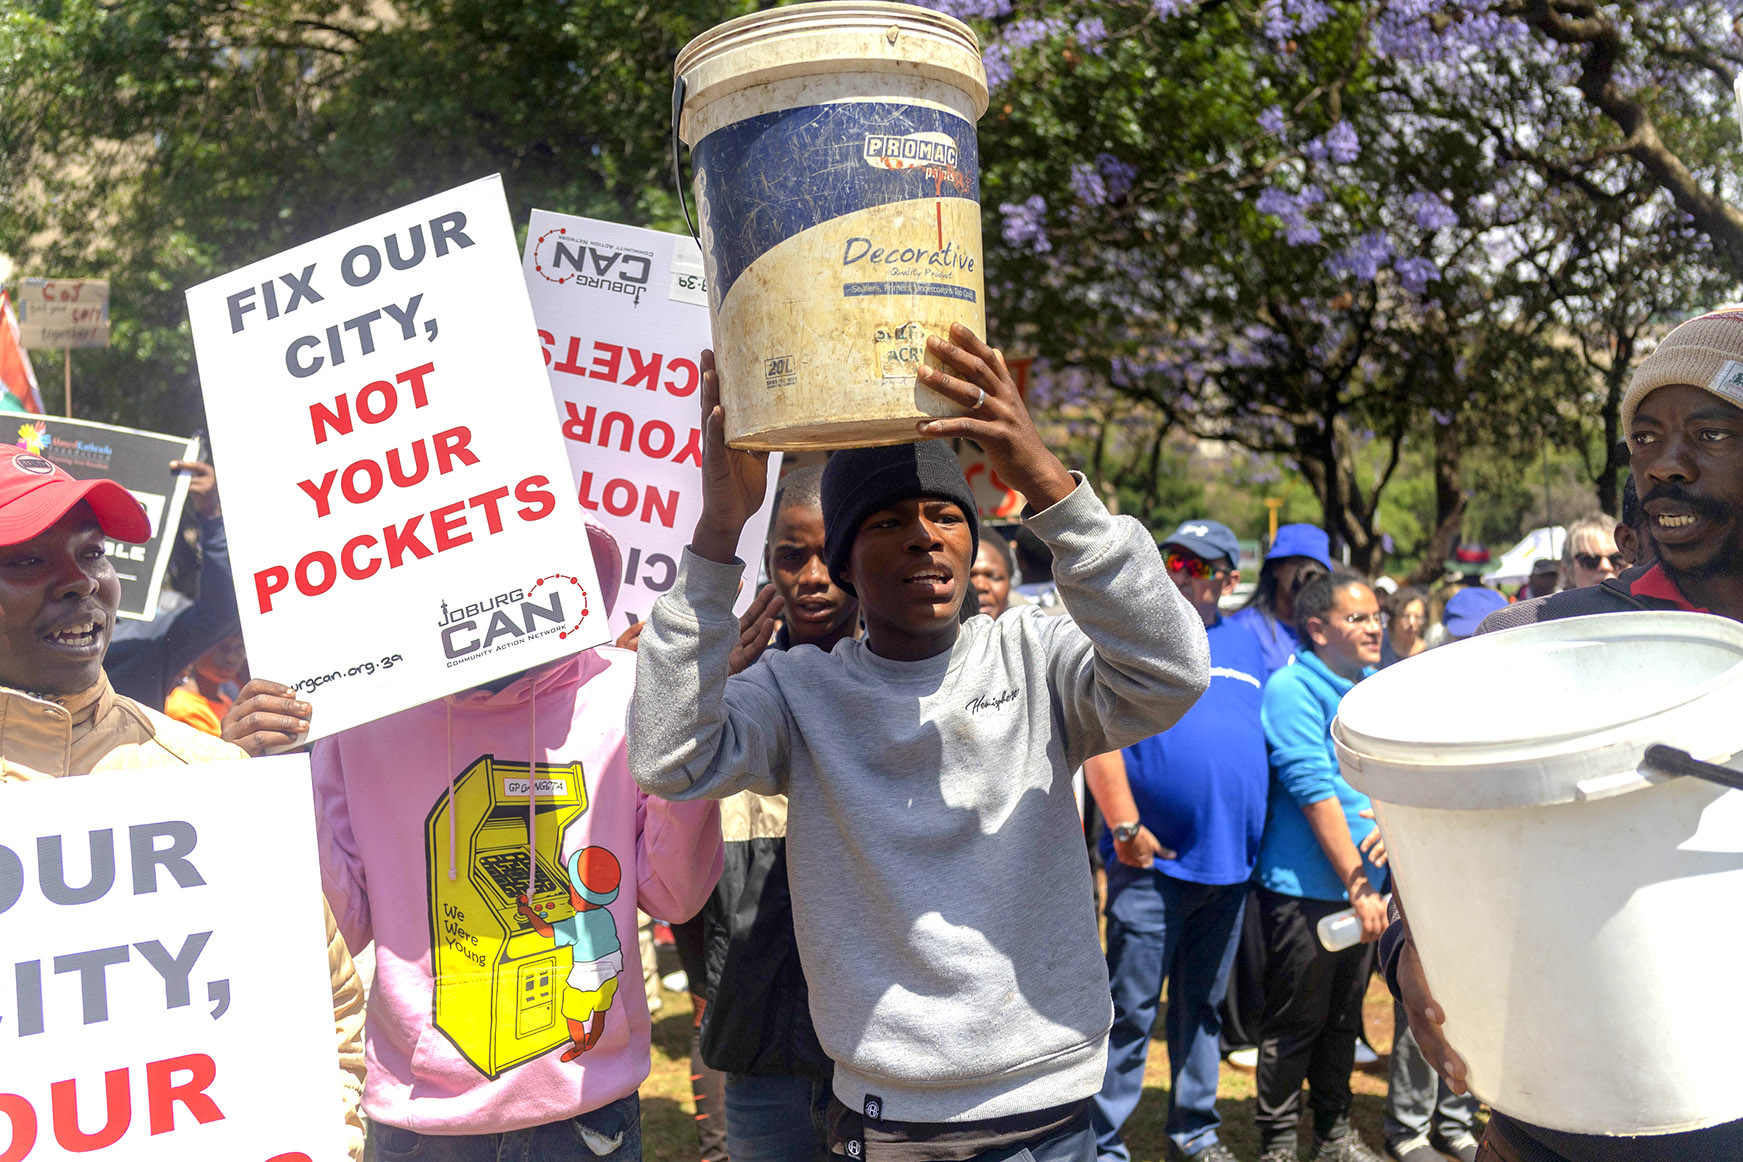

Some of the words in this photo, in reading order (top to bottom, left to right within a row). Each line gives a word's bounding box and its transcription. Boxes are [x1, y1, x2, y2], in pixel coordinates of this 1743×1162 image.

[868, 138, 957, 165] PROMAC
[558, 235, 588, 245] NETWORK
[590, 241, 614, 249] ACTION
[616, 246, 654, 257] COMMUNITY
[843, 237, 975, 272] Decorative
[226, 263, 324, 334] FIX
[341, 211, 475, 287] OUR
[553, 241, 651, 284] CAN
[890, 267, 922, 280] Quality
[925, 268, 953, 279] Product
[576, 274, 647, 306] JOBURG
[285, 293, 438, 378] CITY,
[537, 329, 700, 397] CKETS
[309, 362, 435, 444] NOT
[562, 400, 702, 468] YOUR
[297, 426, 480, 518] YOUR
[578, 471, 680, 529] NOT
[254, 475, 555, 614] POCKETS
[438, 589, 524, 627] JOBURG
[441, 591, 565, 659] CAN
[447, 649, 493, 668] COMMUNITY
[496, 638, 525, 651] ACTION
[528, 625, 566, 641] NETWORK
[443, 903, 465, 921] We
[444, 920, 478, 946] Were
[445, 936, 486, 967] Young
[0, 930, 231, 1038] ITY,
